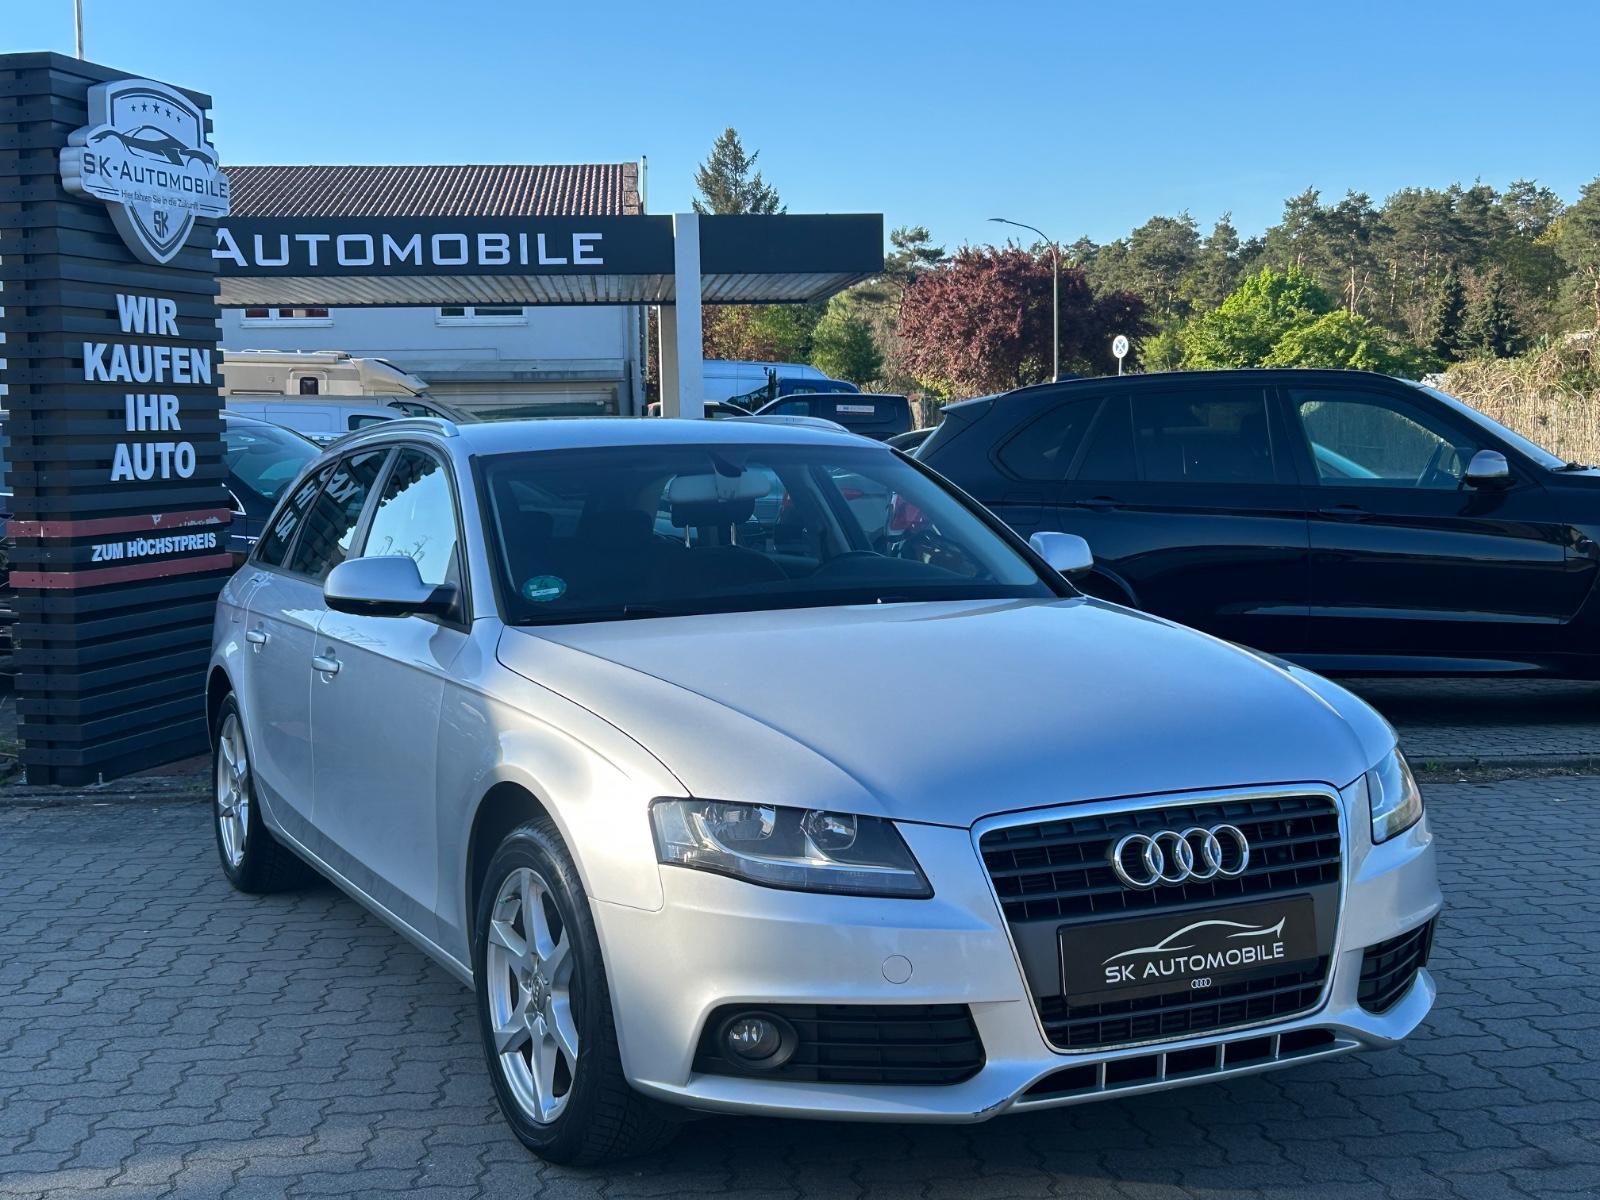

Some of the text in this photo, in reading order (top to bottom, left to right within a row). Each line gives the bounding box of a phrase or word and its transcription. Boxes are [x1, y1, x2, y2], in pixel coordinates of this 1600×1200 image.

[83, 153, 228, 199] SK-AUTOMOBILE
[153, 210, 169, 238] SK
[212, 228, 603, 266] AUTOMOBILE
[115, 293, 180, 336] WIR
[83, 342, 212, 385] KAUFEN
[125, 393, 181, 432] IHR
[110, 441, 196, 481] AUTO
[91, 532, 216, 562] ZUM HÖCHSTPREIS
[1105, 942, 1285, 984] SK AUTOMOBILE
